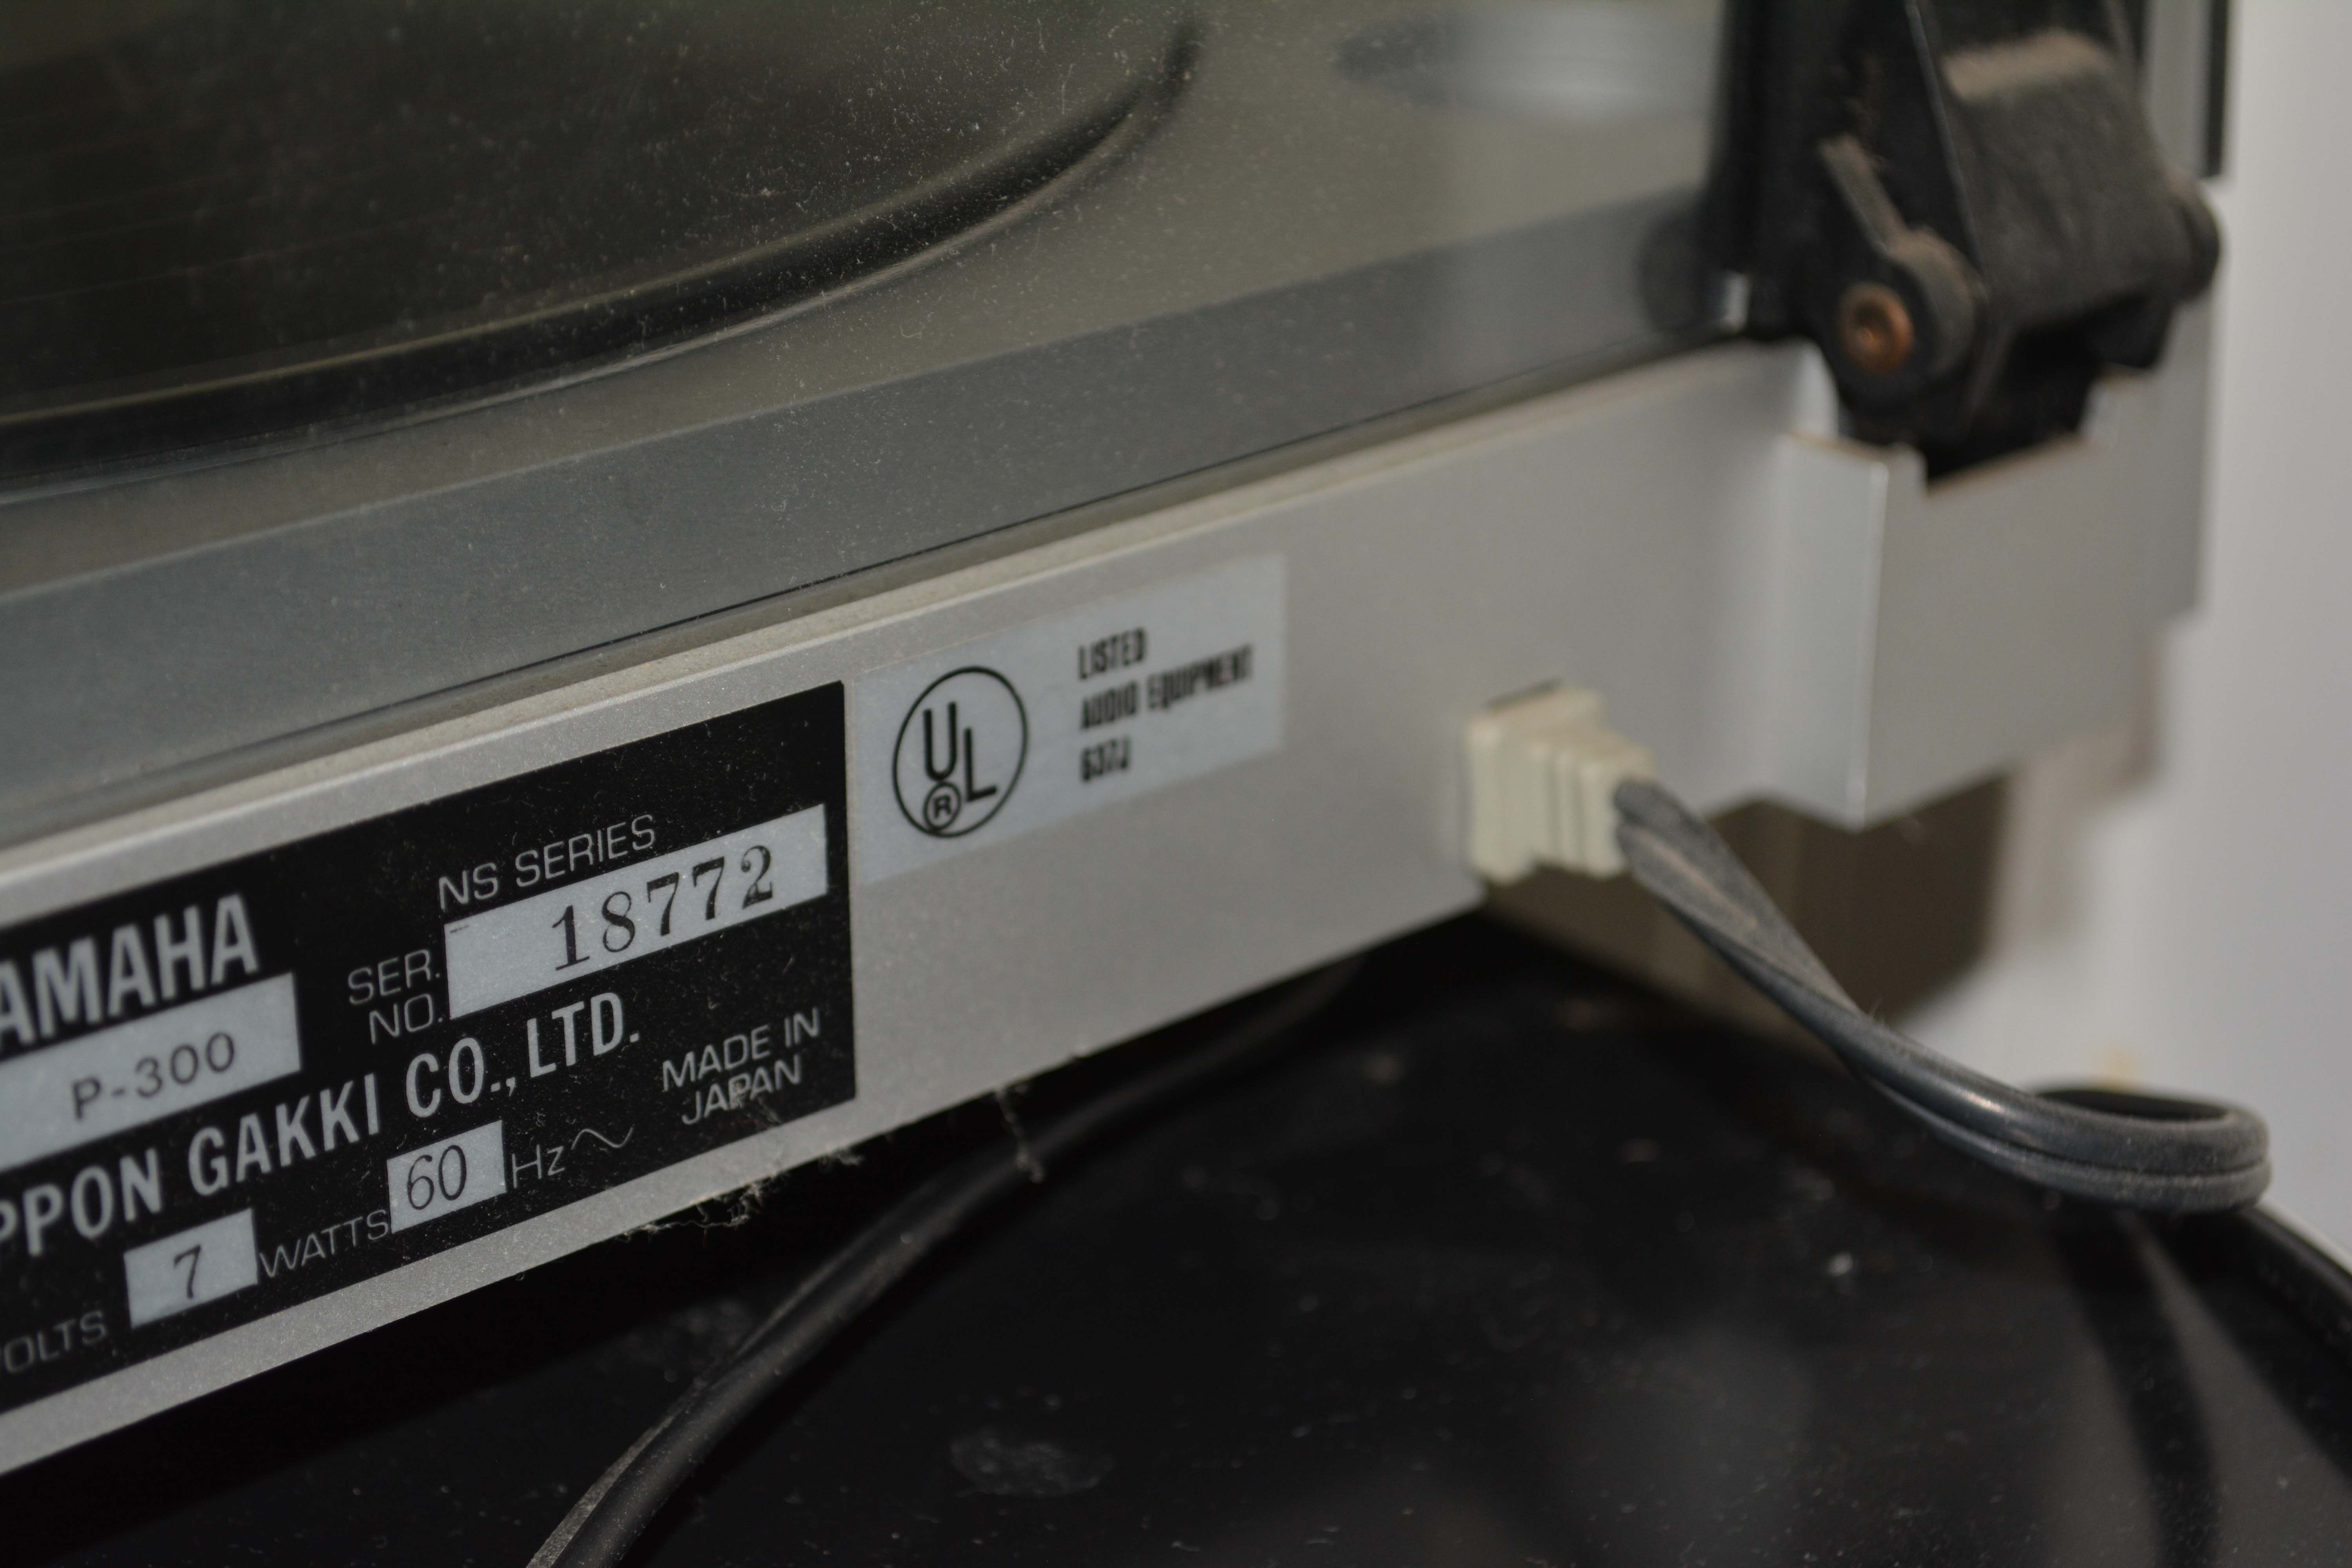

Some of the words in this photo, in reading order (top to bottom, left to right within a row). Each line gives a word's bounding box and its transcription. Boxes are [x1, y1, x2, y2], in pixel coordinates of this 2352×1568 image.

[1077, 626, 1147, 681] LISTED
[1080, 680, 1138, 730] AUDIO
[438, 862, 499, 913] NS
[514, 814, 656, 888] SERIES
[552, 845, 773, 971] 18772
[347, 949, 441, 1005] SER.
[368, 993, 444, 1045] NO.
[72, 1032, 235, 1121] P-300
[662, 1023, 771, 1093] MADE
[784, 1005, 820, 1049] IN
[681, 1053, 802, 1126] JAPAN
[187, 1073, 381, 1197] GAKKI
[174, 1244, 201, 1300] 7
[259, 1209, 389, 1279] WATTS
[406, 1145, 467, 1210] 60
[512, 1144, 566, 1189] Hz
